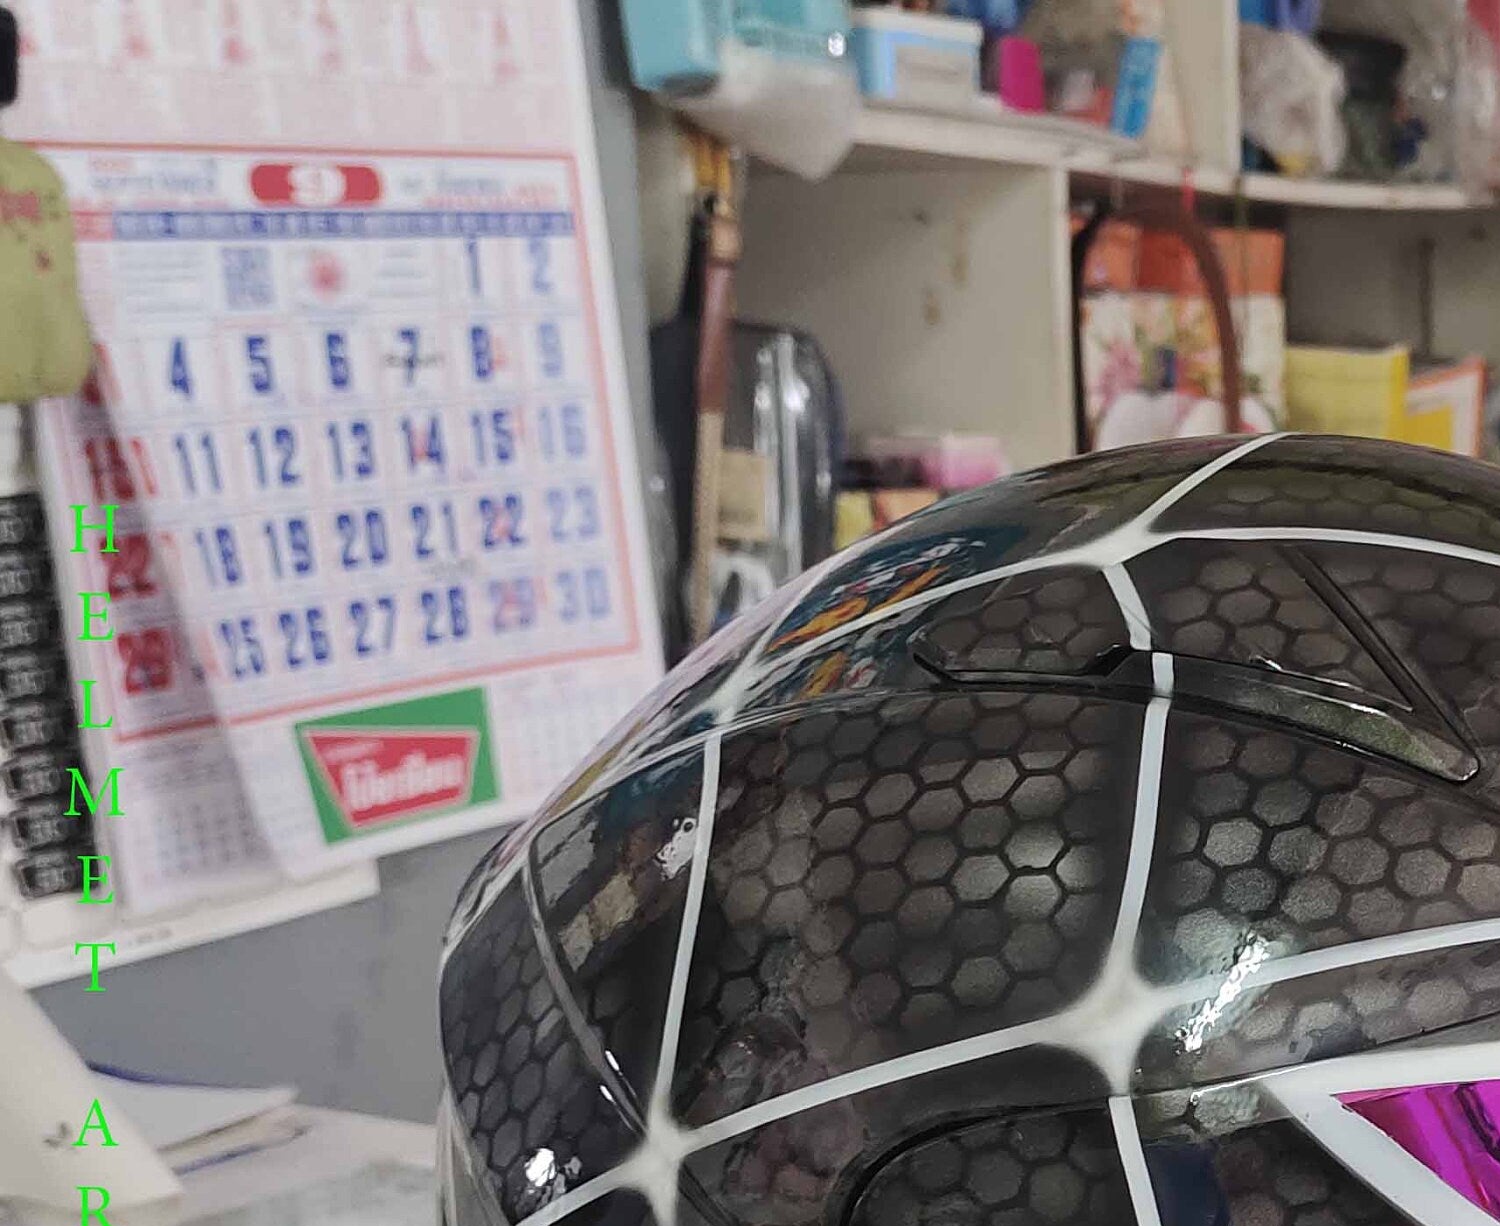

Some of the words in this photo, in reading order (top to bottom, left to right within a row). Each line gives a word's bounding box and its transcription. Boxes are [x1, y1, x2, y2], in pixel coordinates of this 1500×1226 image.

[170, 337, 193, 396] 4
[245, 332, 273, 394] 5
[325, 330, 352, 389] 6
[398, 325, 421, 387] 7
[469, 323, 493, 380] 8
[174, 432, 222, 494] 11
[248, 425, 300, 488] 12
[327, 419, 376, 482] 13
[399, 414, 447, 475] 14
[470, 408, 516, 467] 15
[536, 402, 588, 462] 16
[195, 526, 241, 587] 18
[262, 518, 313, 582] 19
[336, 510, 389, 571] 20
[410, 503, 459, 560] 21
[477, 492, 528, 548] 22
[546, 484, 602, 542] 23
[218, 616, 267, 681] 25
[277, 606, 332, 668] 26
[348, 597, 398, 659] 27
[419, 587, 469, 645] 28
[556, 568, 612, 625] 30
